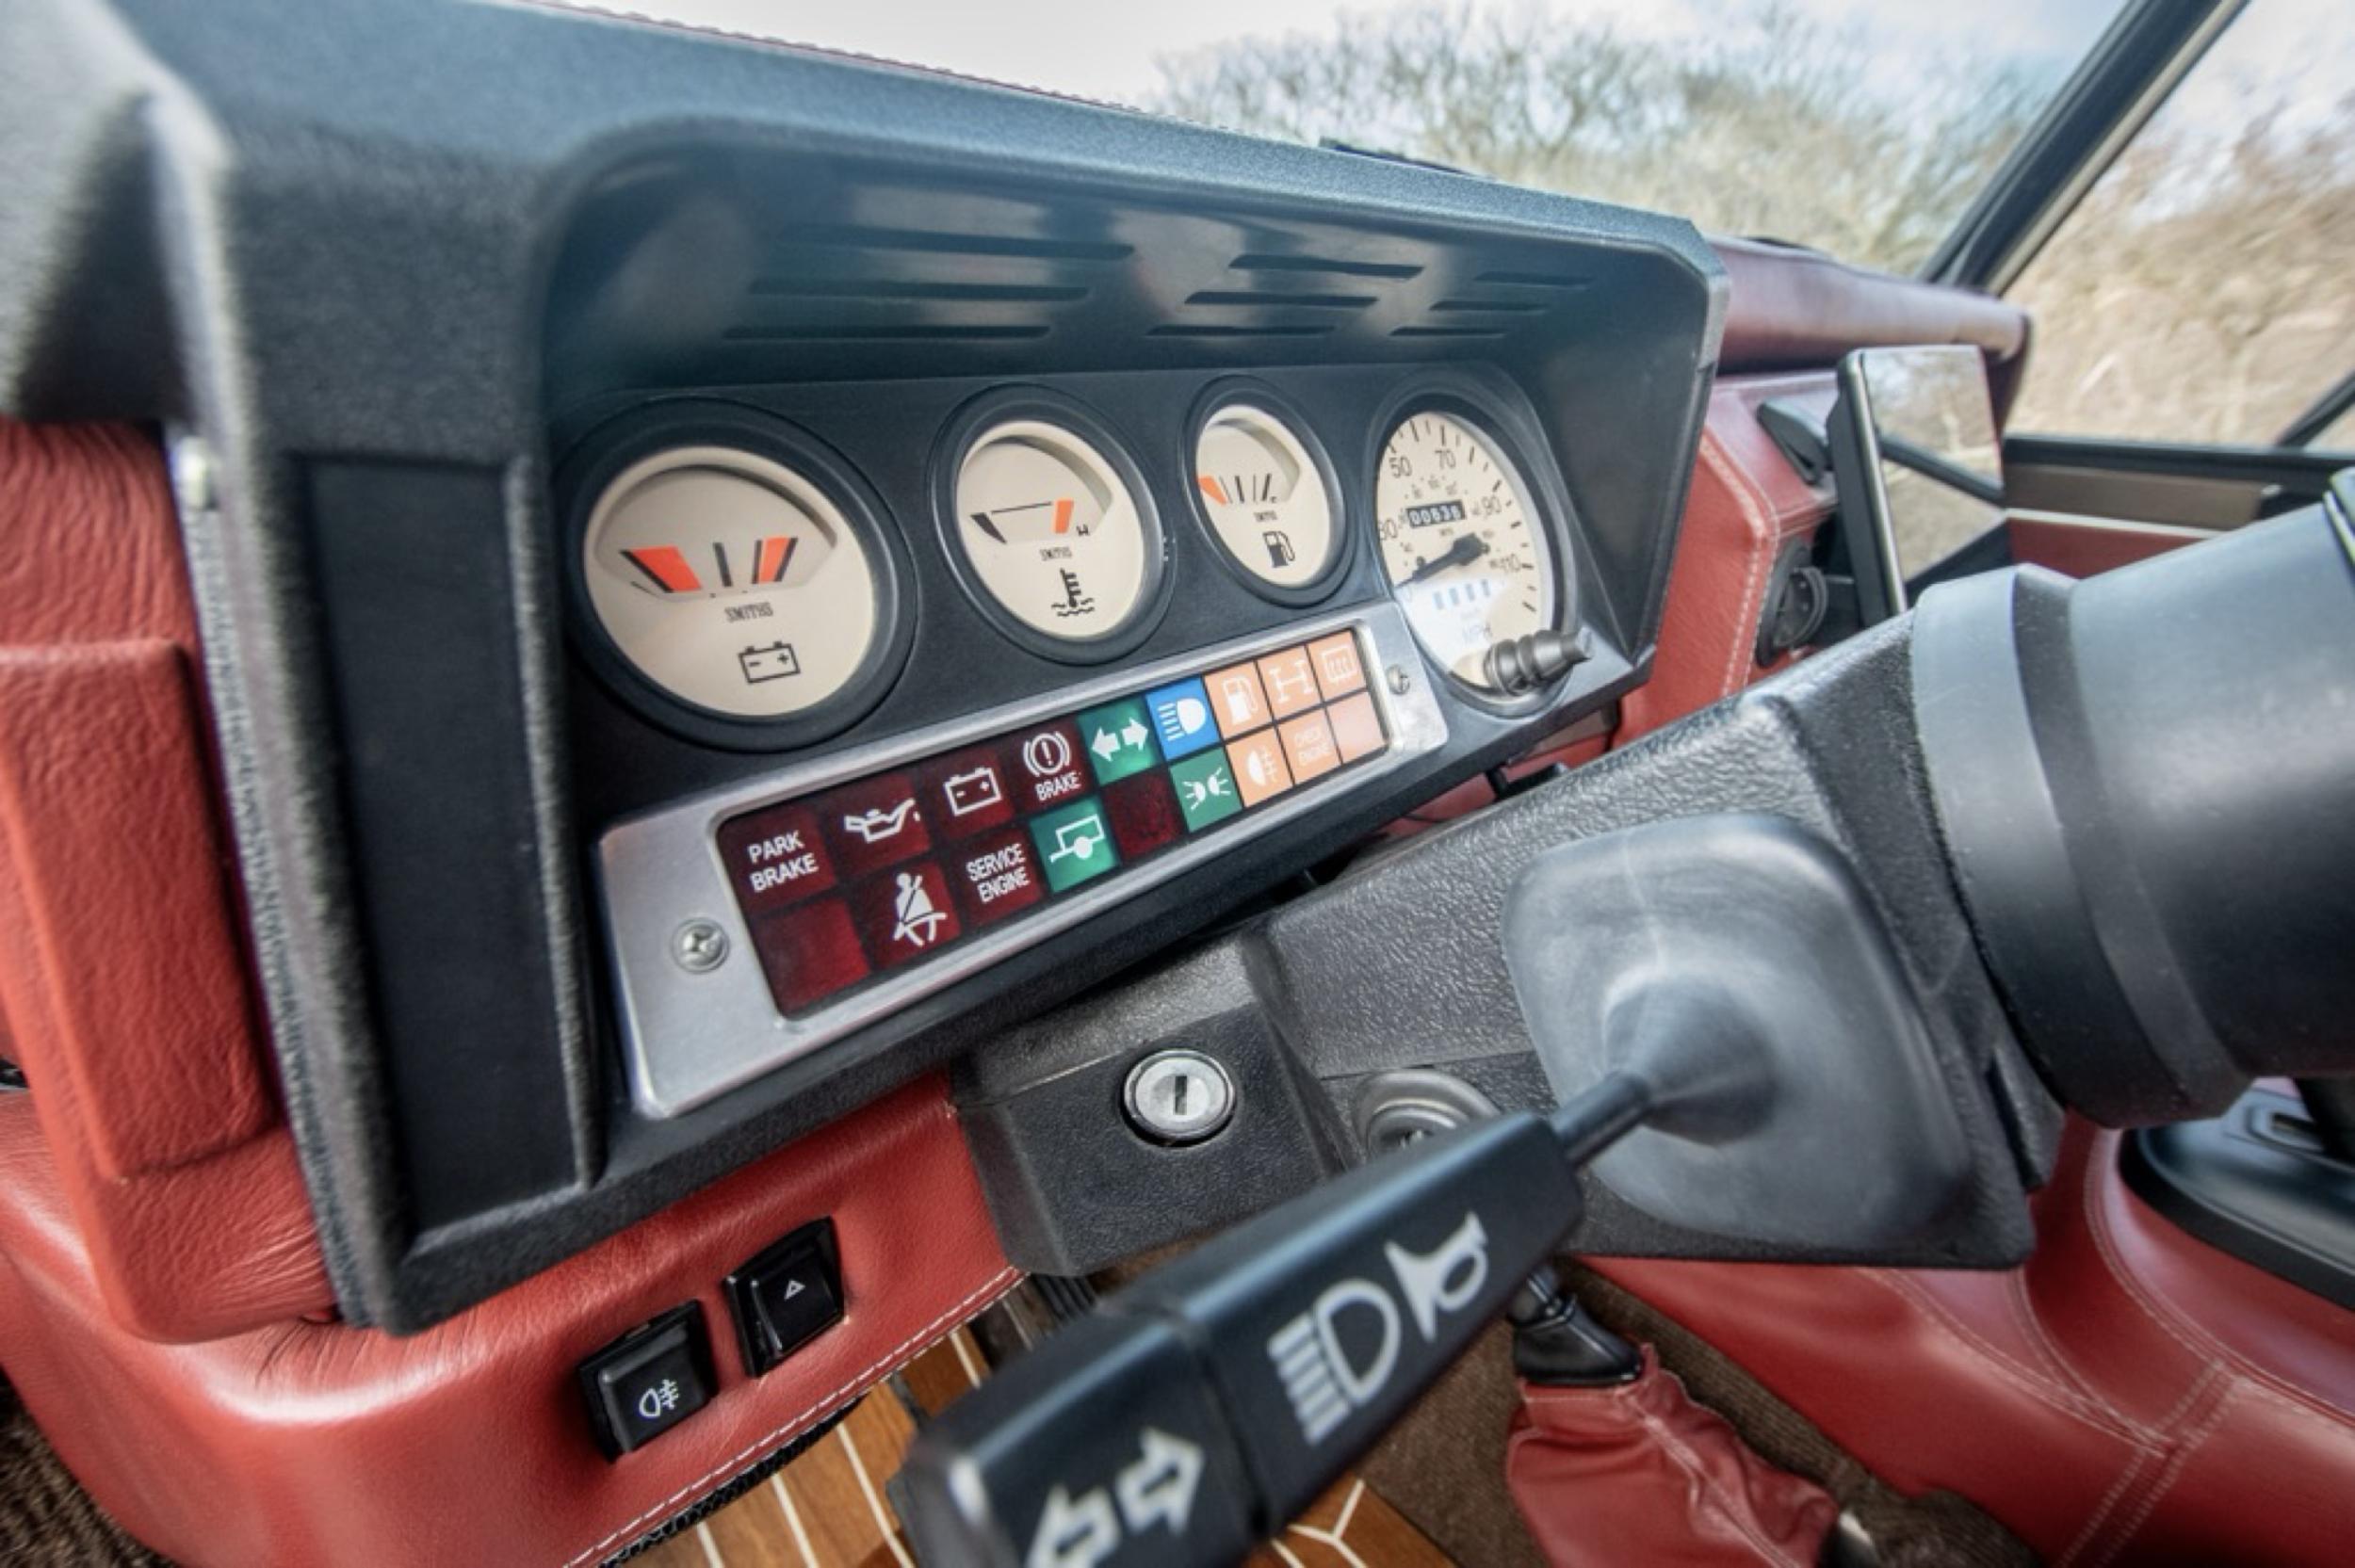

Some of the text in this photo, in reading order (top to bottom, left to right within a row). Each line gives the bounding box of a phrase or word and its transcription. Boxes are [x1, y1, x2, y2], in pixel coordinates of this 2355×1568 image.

[1389, 456, 1413, 478] 50
[1435, 448, 1456, 470] 70
[723, 601, 774, 623] SMITHS
[1034, 770, 1082, 801] BRAKE
[747, 829, 806, 865] PARK
[966, 842, 1027, 881] SERVICE
[750, 851, 820, 893] BRAKE
[978, 865, 1031, 903] ENGINE
